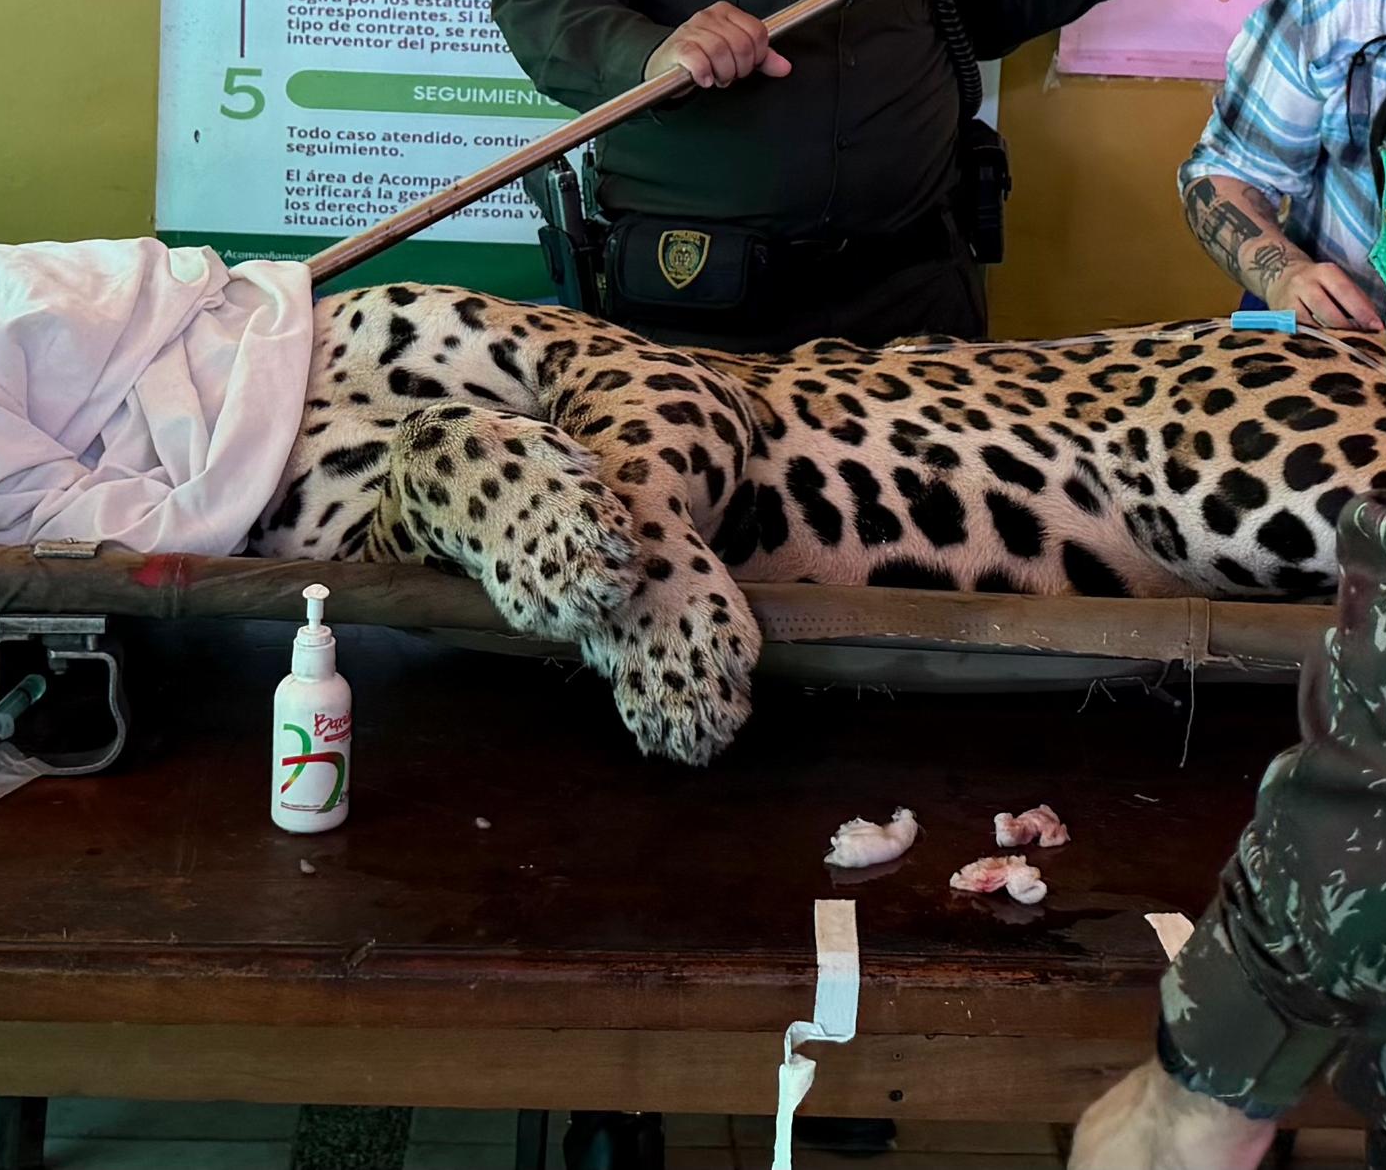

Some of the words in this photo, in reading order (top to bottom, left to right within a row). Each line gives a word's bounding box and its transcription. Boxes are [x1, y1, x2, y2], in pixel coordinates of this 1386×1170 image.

[219, 67, 266, 120] 5
[287, 124, 331, 139] Todo
[336, 130, 376, 141] caso
[381, 128, 467, 149] atendido,
[286, 139, 403, 160] seguimiento.
[284, 210, 366, 227] situación
